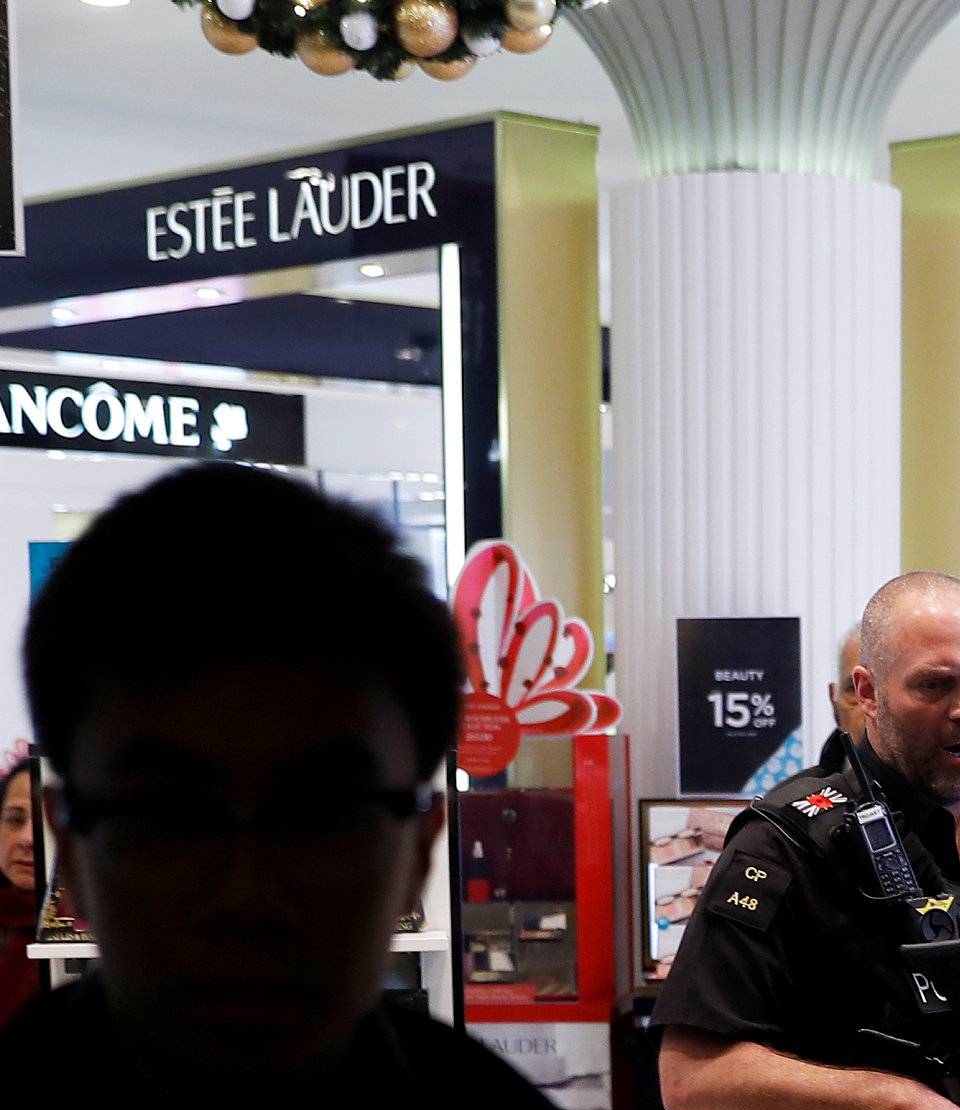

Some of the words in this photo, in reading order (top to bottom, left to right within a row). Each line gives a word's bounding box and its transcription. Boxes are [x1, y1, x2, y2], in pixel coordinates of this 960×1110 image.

[268, 160, 437, 242] LAUDER
[713, 669, 765, 682] BEAUTY
[753, 717, 777, 729] OFF
[744, 866, 768, 883] CP
[726, 891, 759, 911] A48
